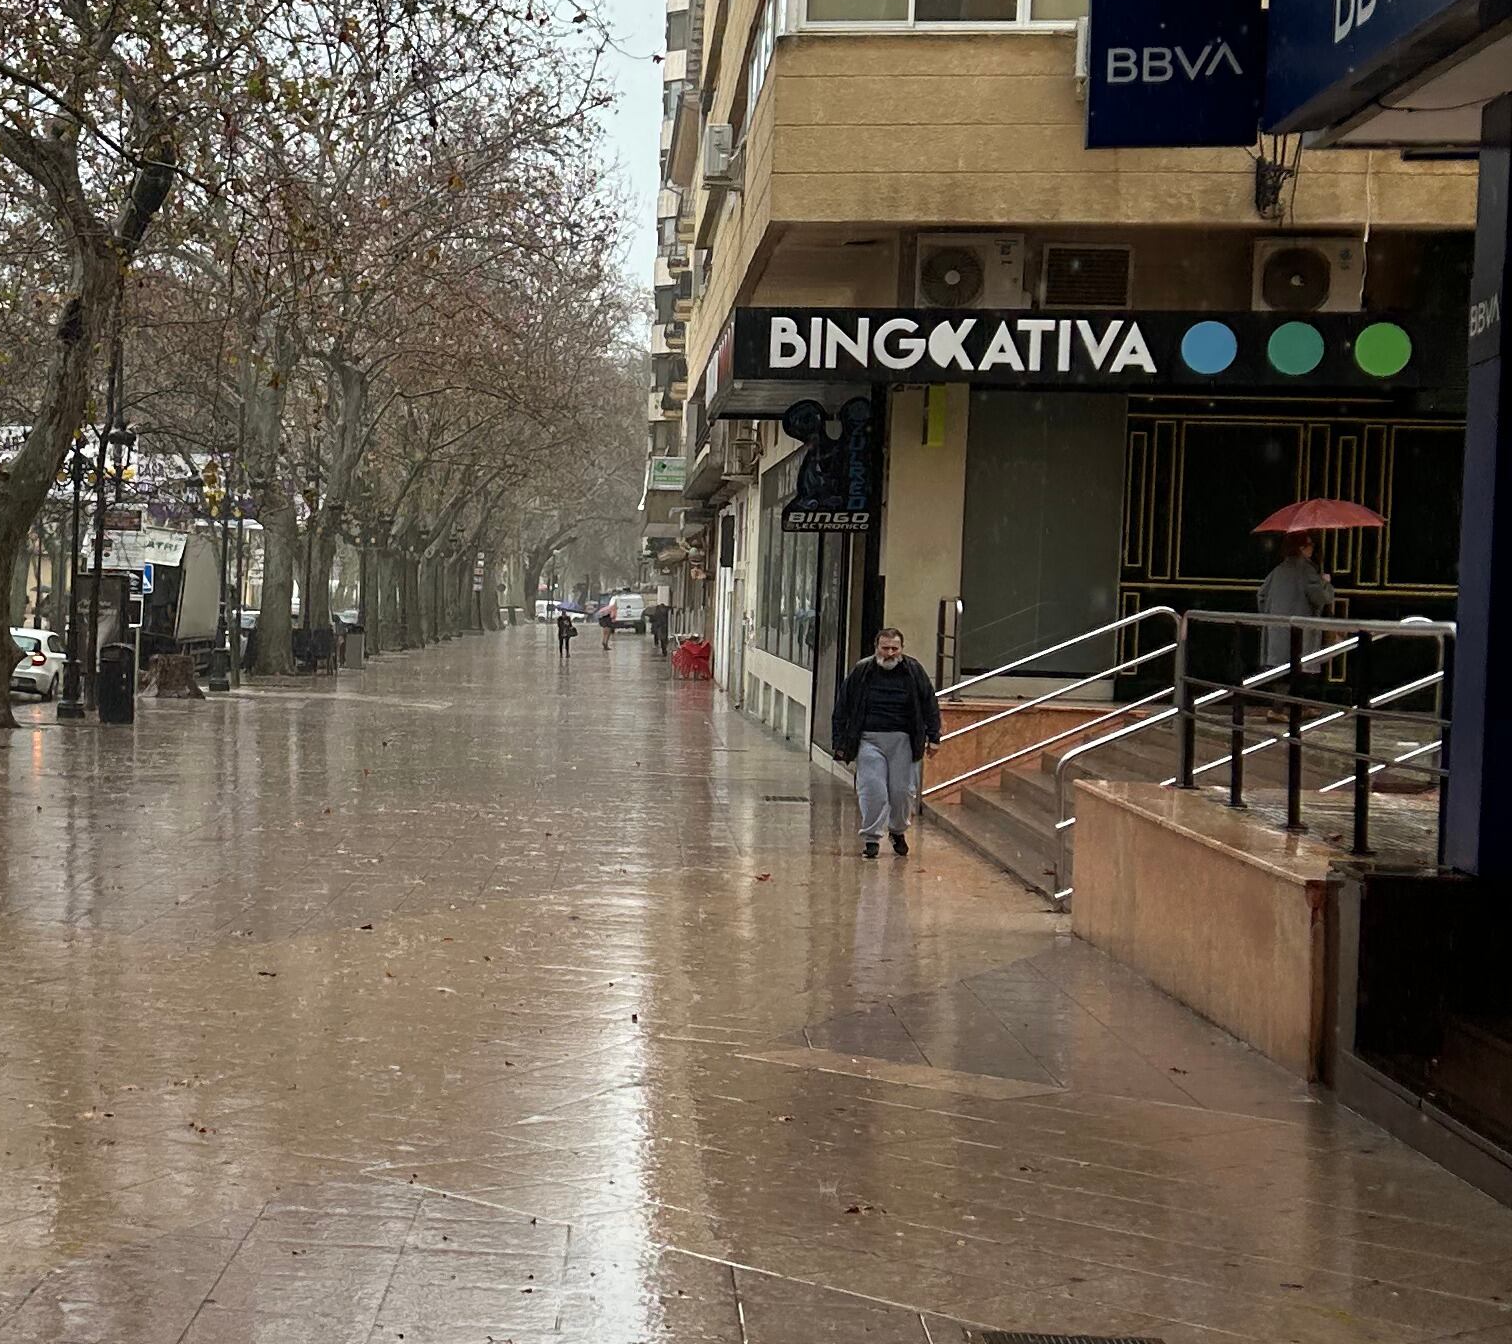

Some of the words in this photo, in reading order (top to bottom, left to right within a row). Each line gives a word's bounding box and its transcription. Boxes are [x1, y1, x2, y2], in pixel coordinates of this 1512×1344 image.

[1107, 42, 1243, 84] BBVA
[1470, 292, 1500, 337] BBVA
[788, 512, 870, 523] BINGO
